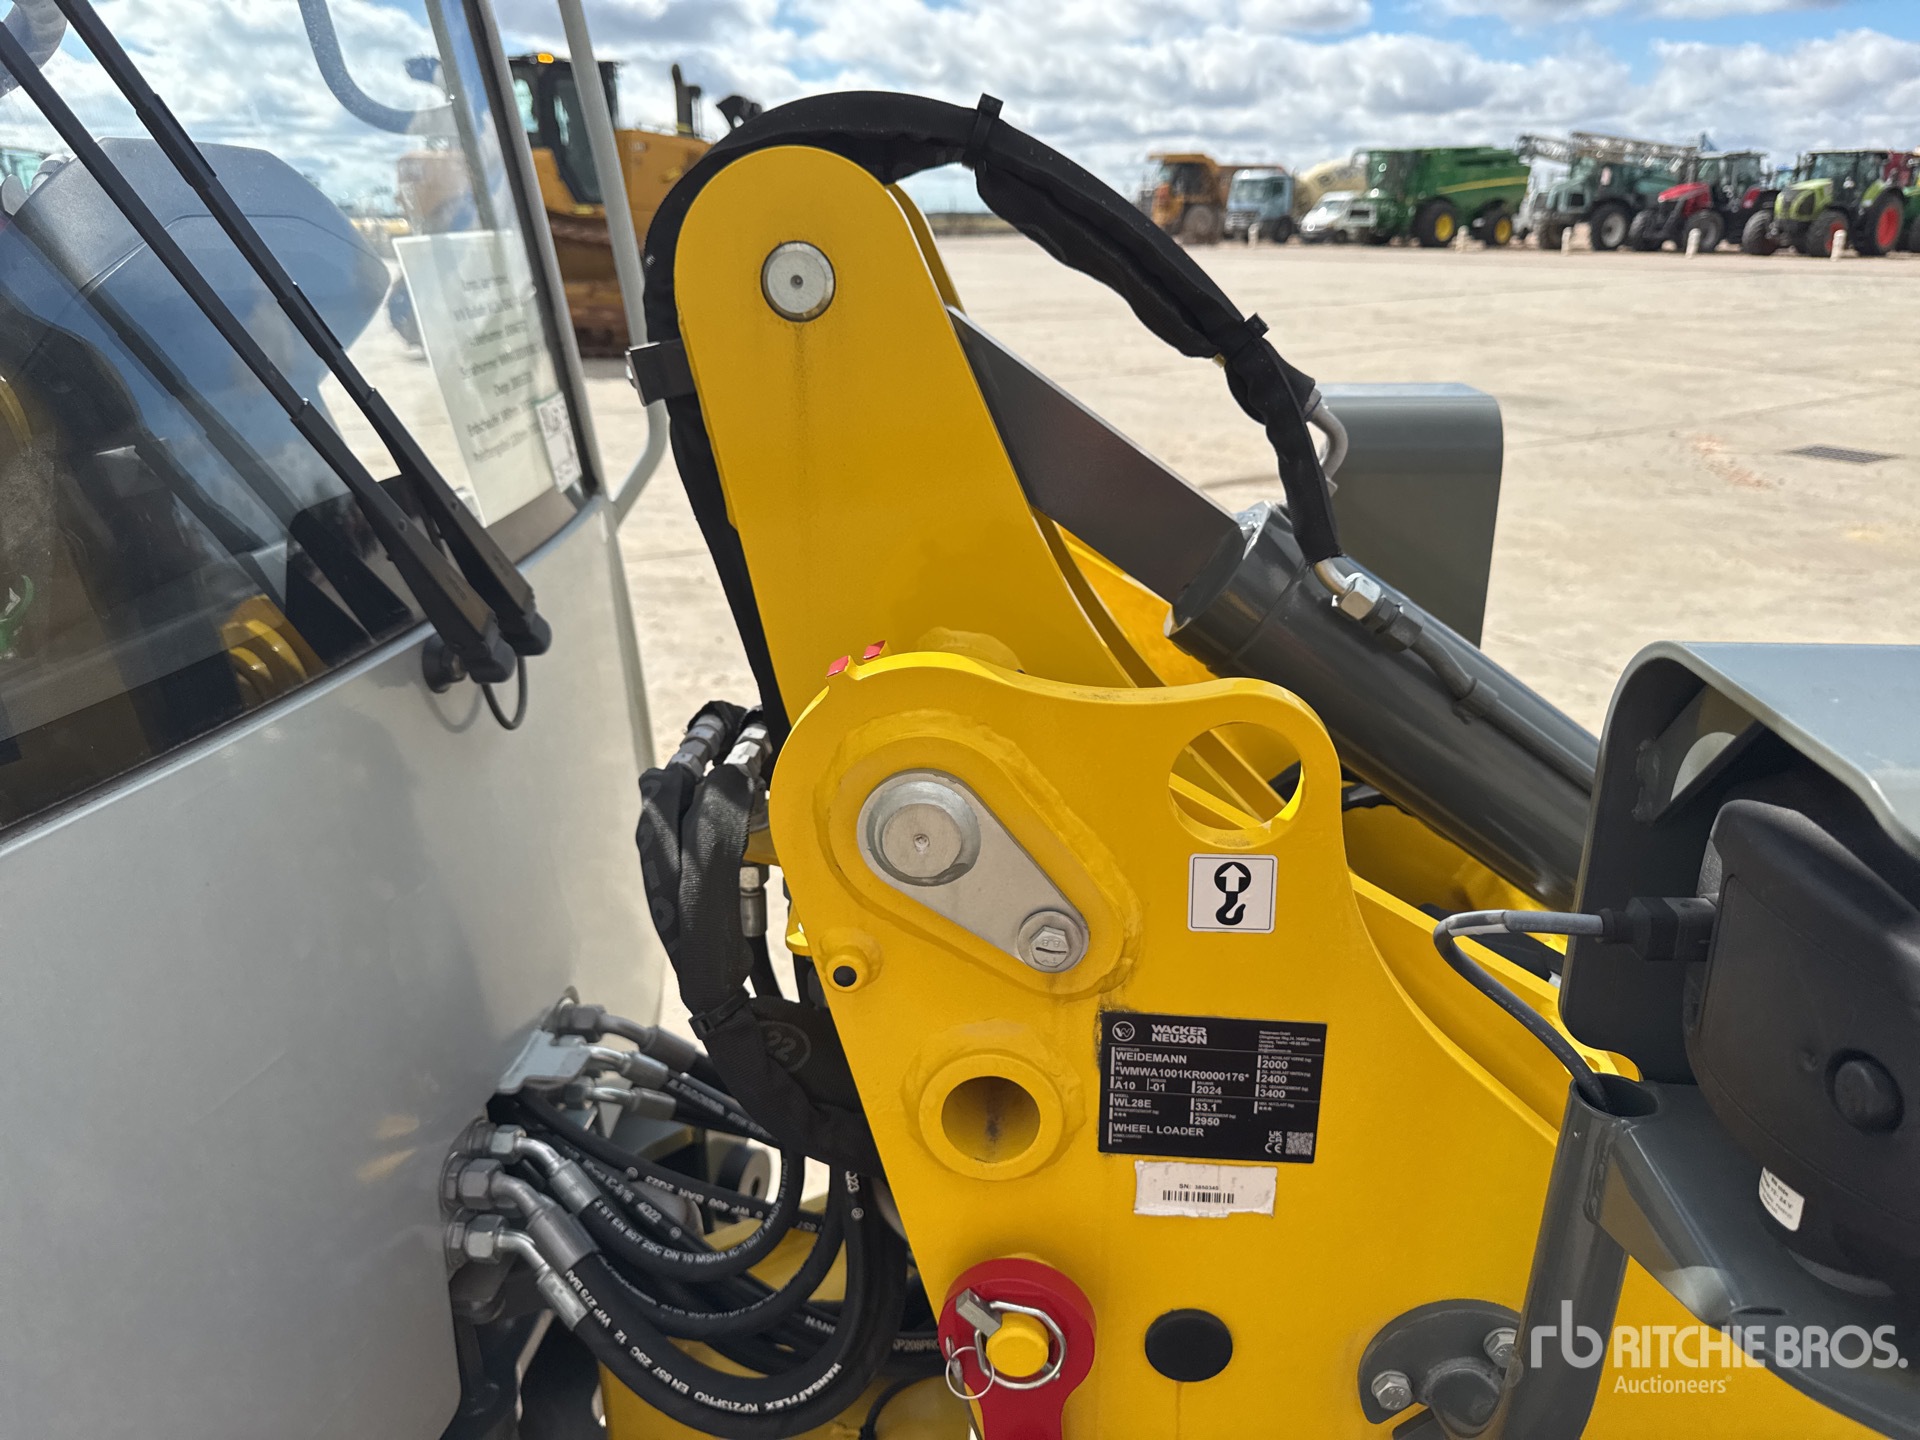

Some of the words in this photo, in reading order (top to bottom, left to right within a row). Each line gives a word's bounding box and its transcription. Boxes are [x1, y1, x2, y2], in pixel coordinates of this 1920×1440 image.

[1151, 1024, 1207, 1036] WACKER
[1151, 1033, 1207, 1045] NEUSON
[1115, 1051, 1188, 1064] WEIDEMANN
[1262, 1060, 1289, 1070] 2000
[1260, 1074, 1288, 1084] 2400
[1114, 1080, 1136, 1090] A10
[1150, 1083, 1166, 1092] -01
[1196, 1086, 1222, 1096] 2024
[1260, 1089, 1286, 1099] 3400
[1114, 1098, 1152, 1108] WL28E
[1195, 1102, 1217, 1112] 33.1
[1194, 1117, 1220, 1127] 2950
[1113, 1123, 1154, 1134] WHEEL
[1156, 1126, 1205, 1137] LOADER
[695, 1251, 728, 1264] MSHA
[593, 1308, 612, 1328] WP
[614, 1329, 628, 1345] 12
[630, 1346, 653, 1368] 2SC
[671, 1378, 691, 1395] EN
